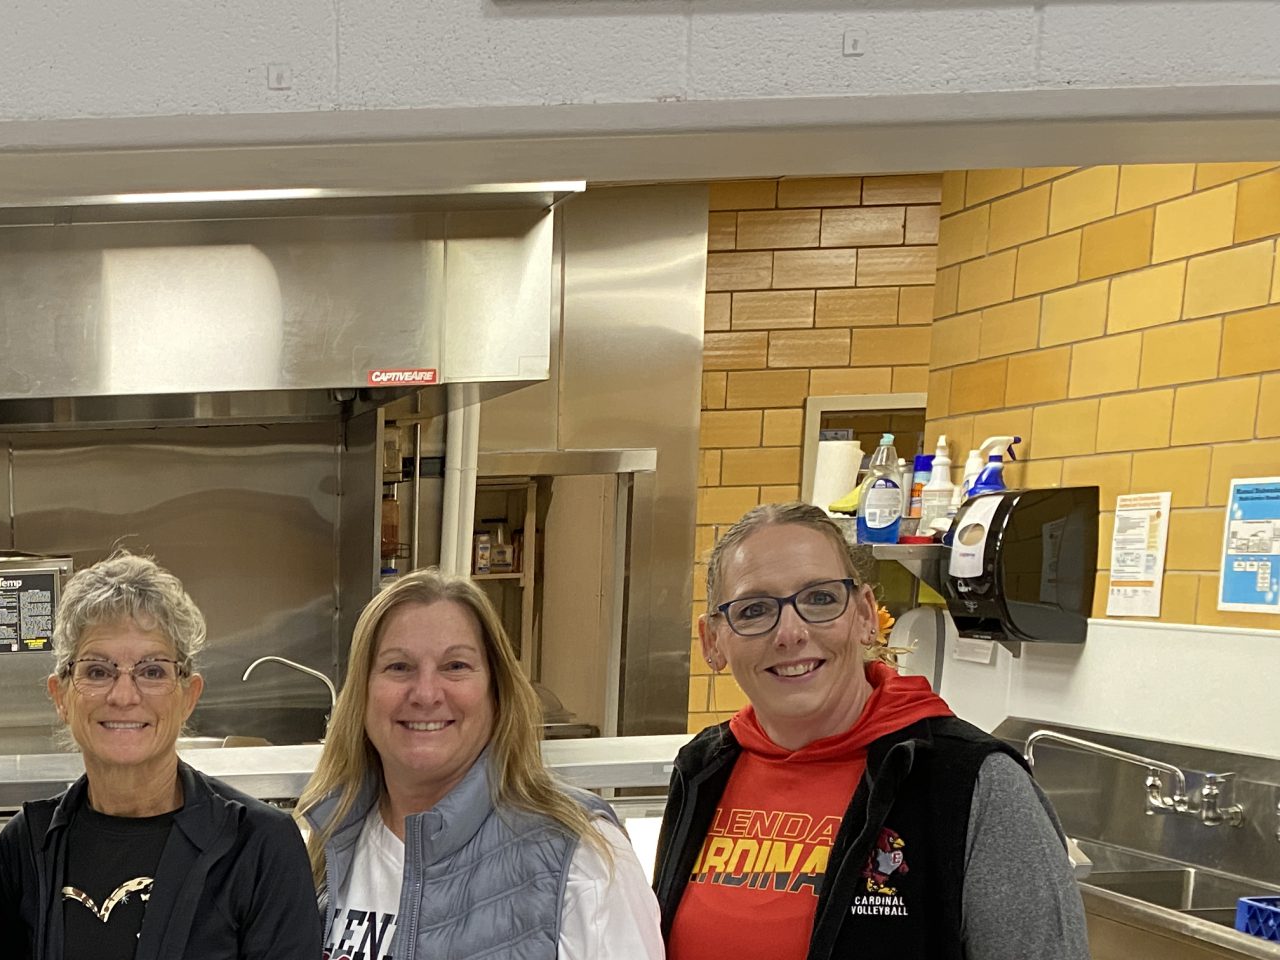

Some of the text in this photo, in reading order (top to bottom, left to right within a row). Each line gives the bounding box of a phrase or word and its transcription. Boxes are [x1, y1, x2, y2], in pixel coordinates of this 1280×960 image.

[371, 371, 434, 382] CAPTIVEAIRE
[854, 895, 905, 906] CARDINAL
[851, 905, 909, 916] VOLLEYBALL
